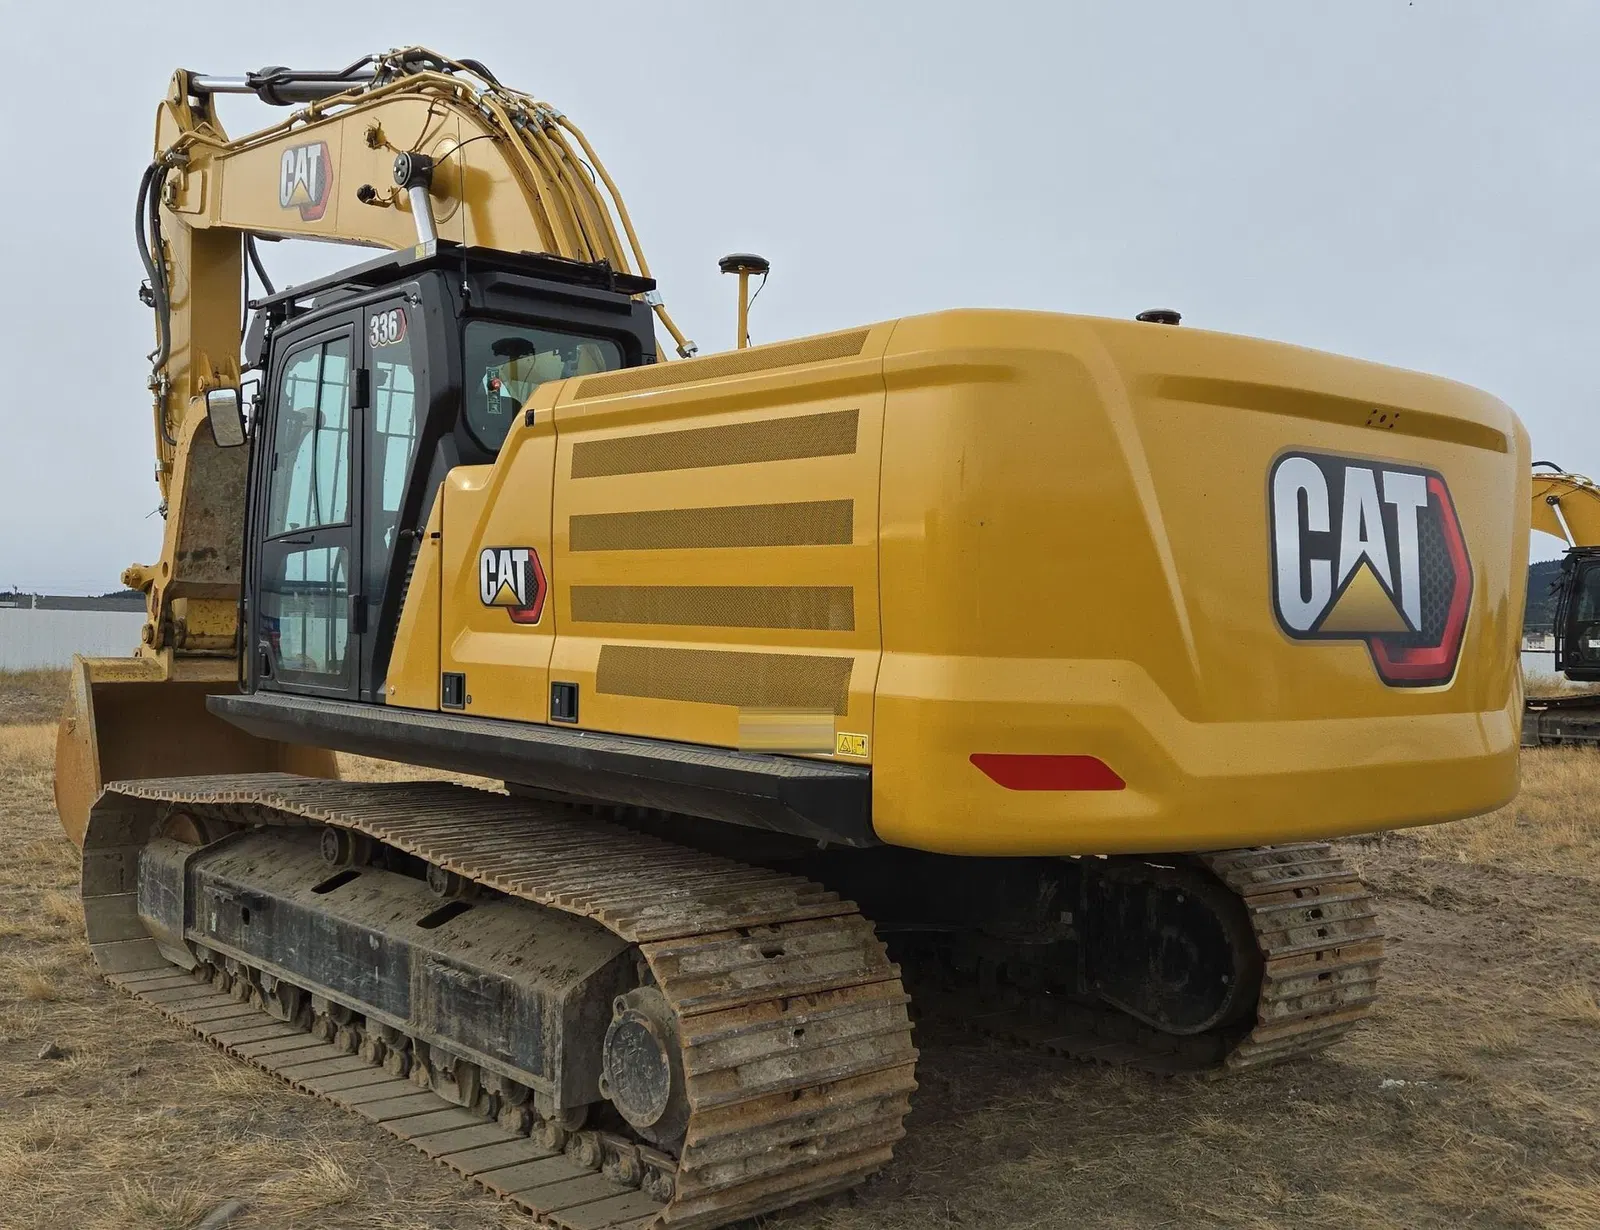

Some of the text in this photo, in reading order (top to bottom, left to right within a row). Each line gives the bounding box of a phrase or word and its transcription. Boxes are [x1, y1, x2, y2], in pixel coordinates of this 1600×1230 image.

[281, 144, 321, 206] CAT
[370, 310, 398, 345] 336
[1274, 457, 1428, 632] CAT
[481, 549, 528, 605] CAT
